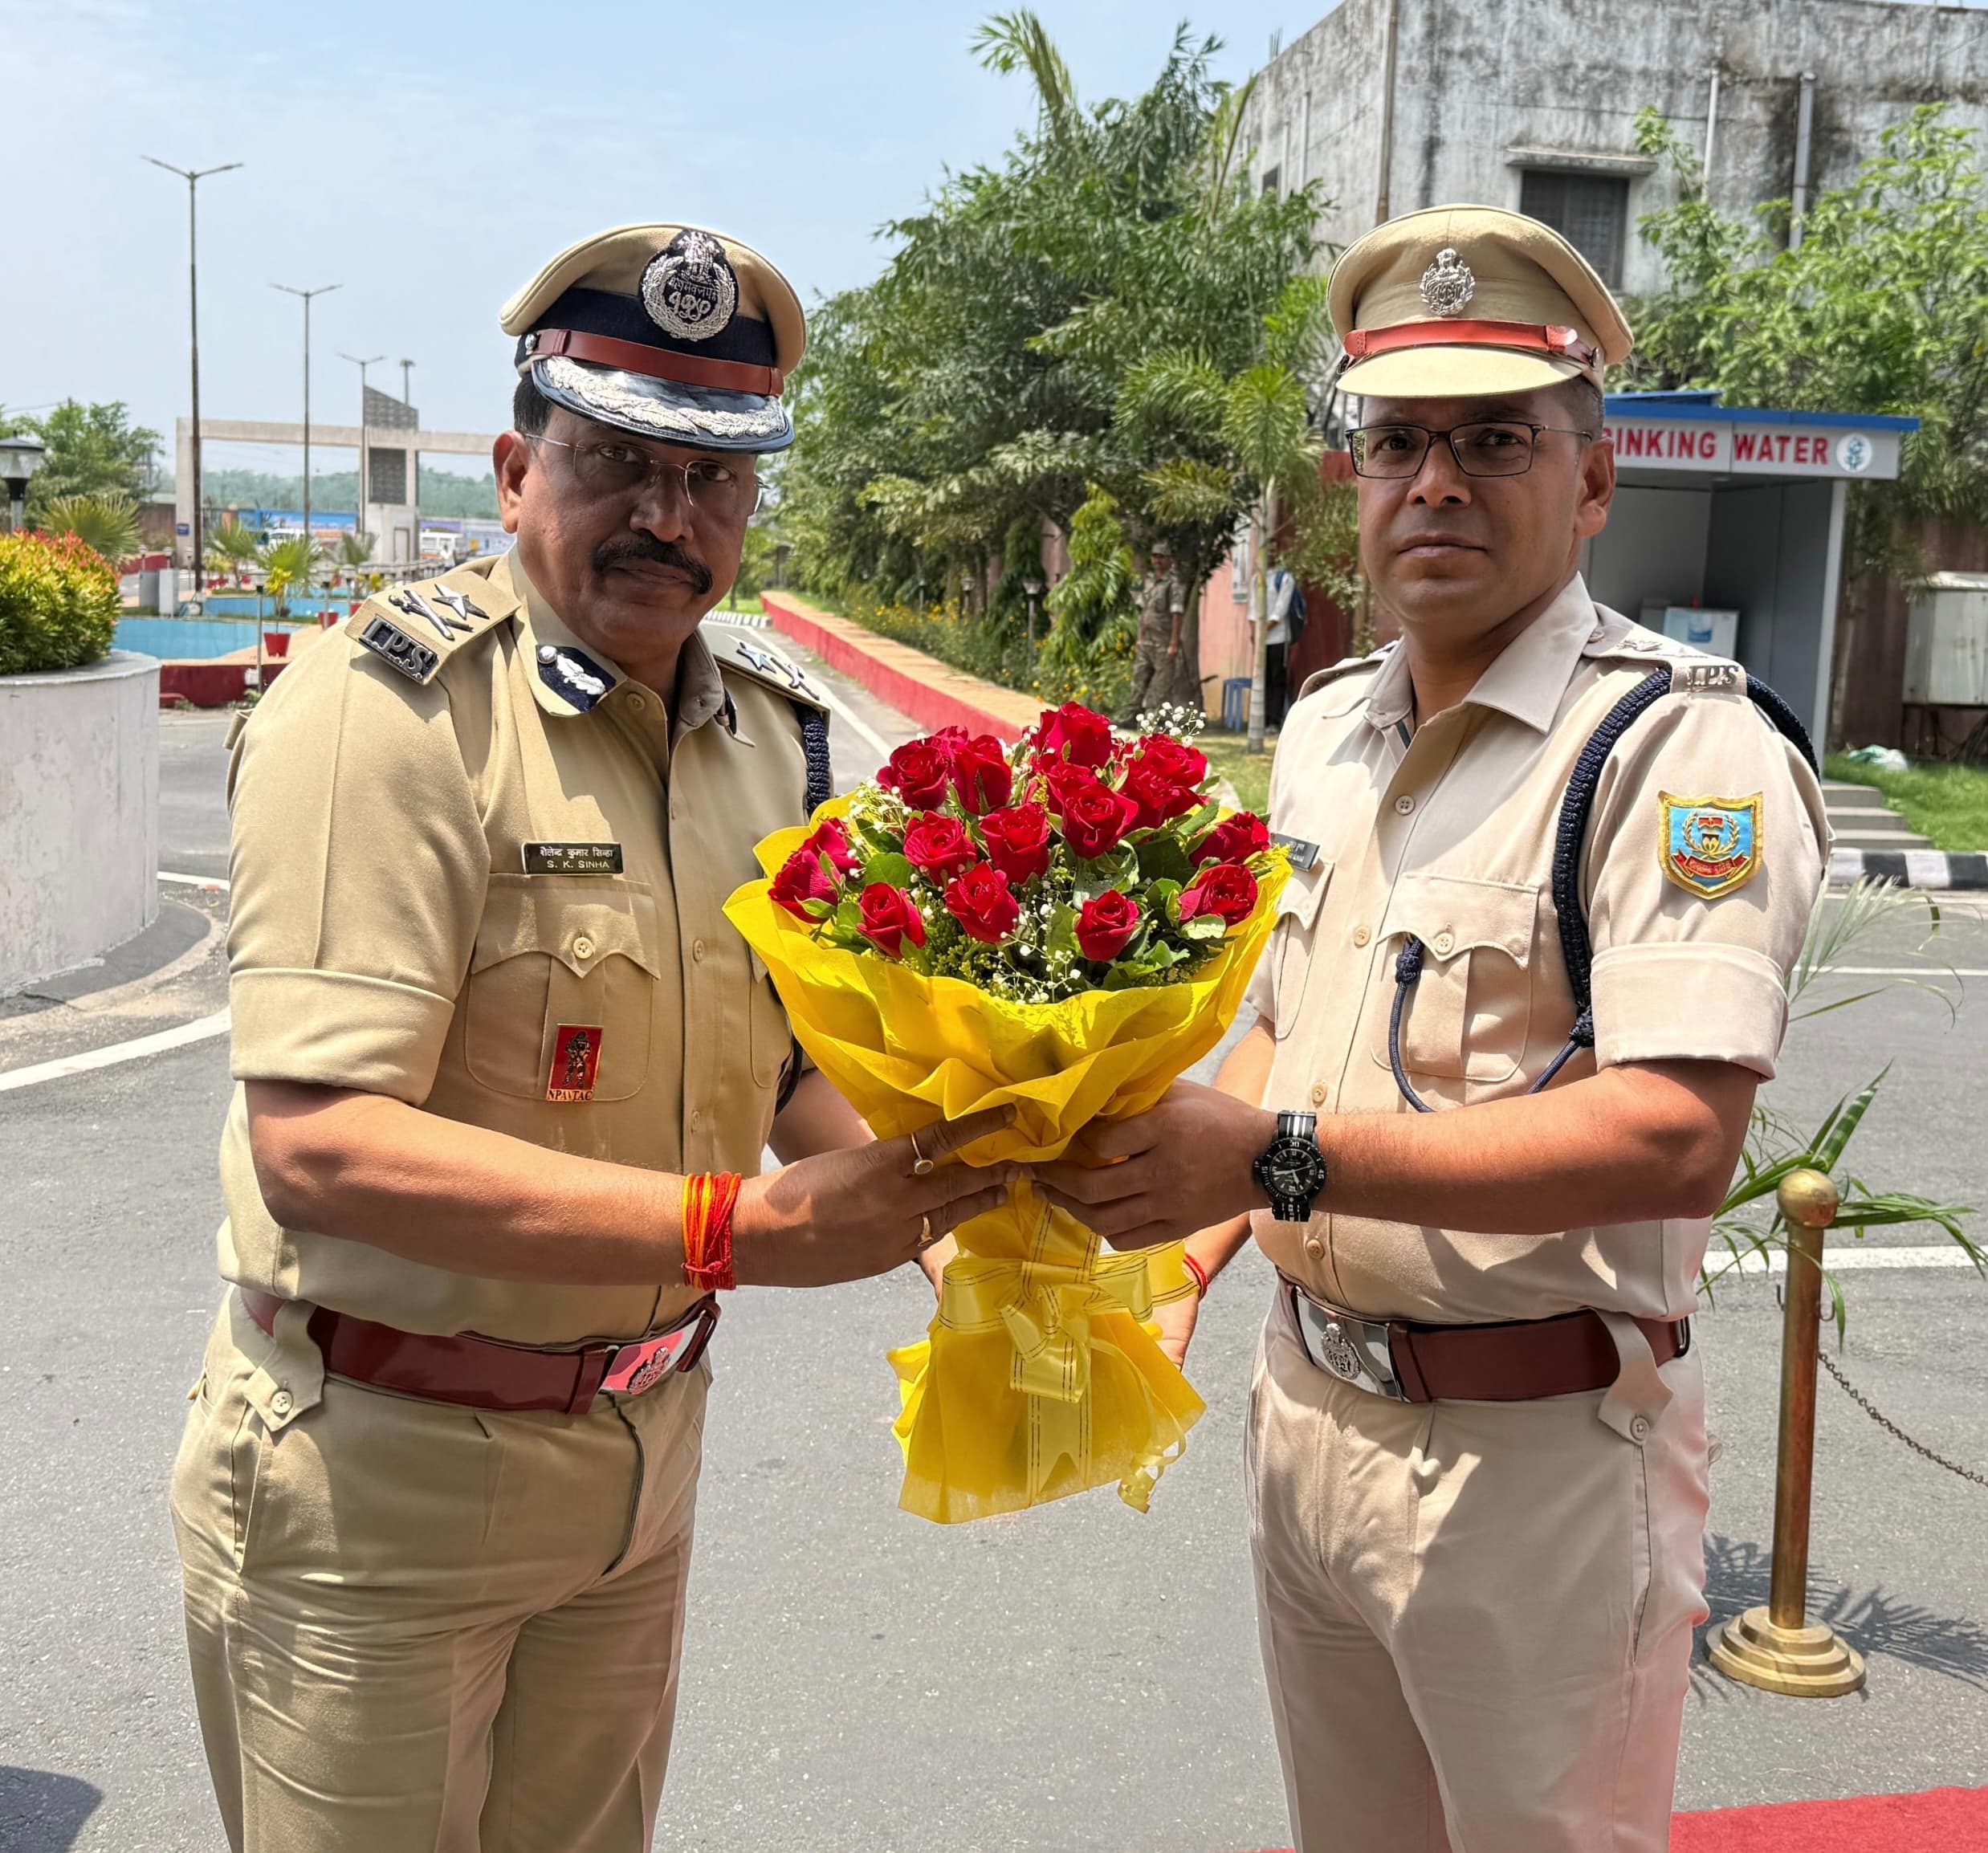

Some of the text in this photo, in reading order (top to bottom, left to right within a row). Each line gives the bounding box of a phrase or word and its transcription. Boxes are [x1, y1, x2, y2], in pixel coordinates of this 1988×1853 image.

[1733, 434, 1828, 465] WATER
[567, 849, 589, 858] कुमार
[593, 847, 613, 857] सिन्हा
[547, 861, 610, 869] S. K. SINHA
